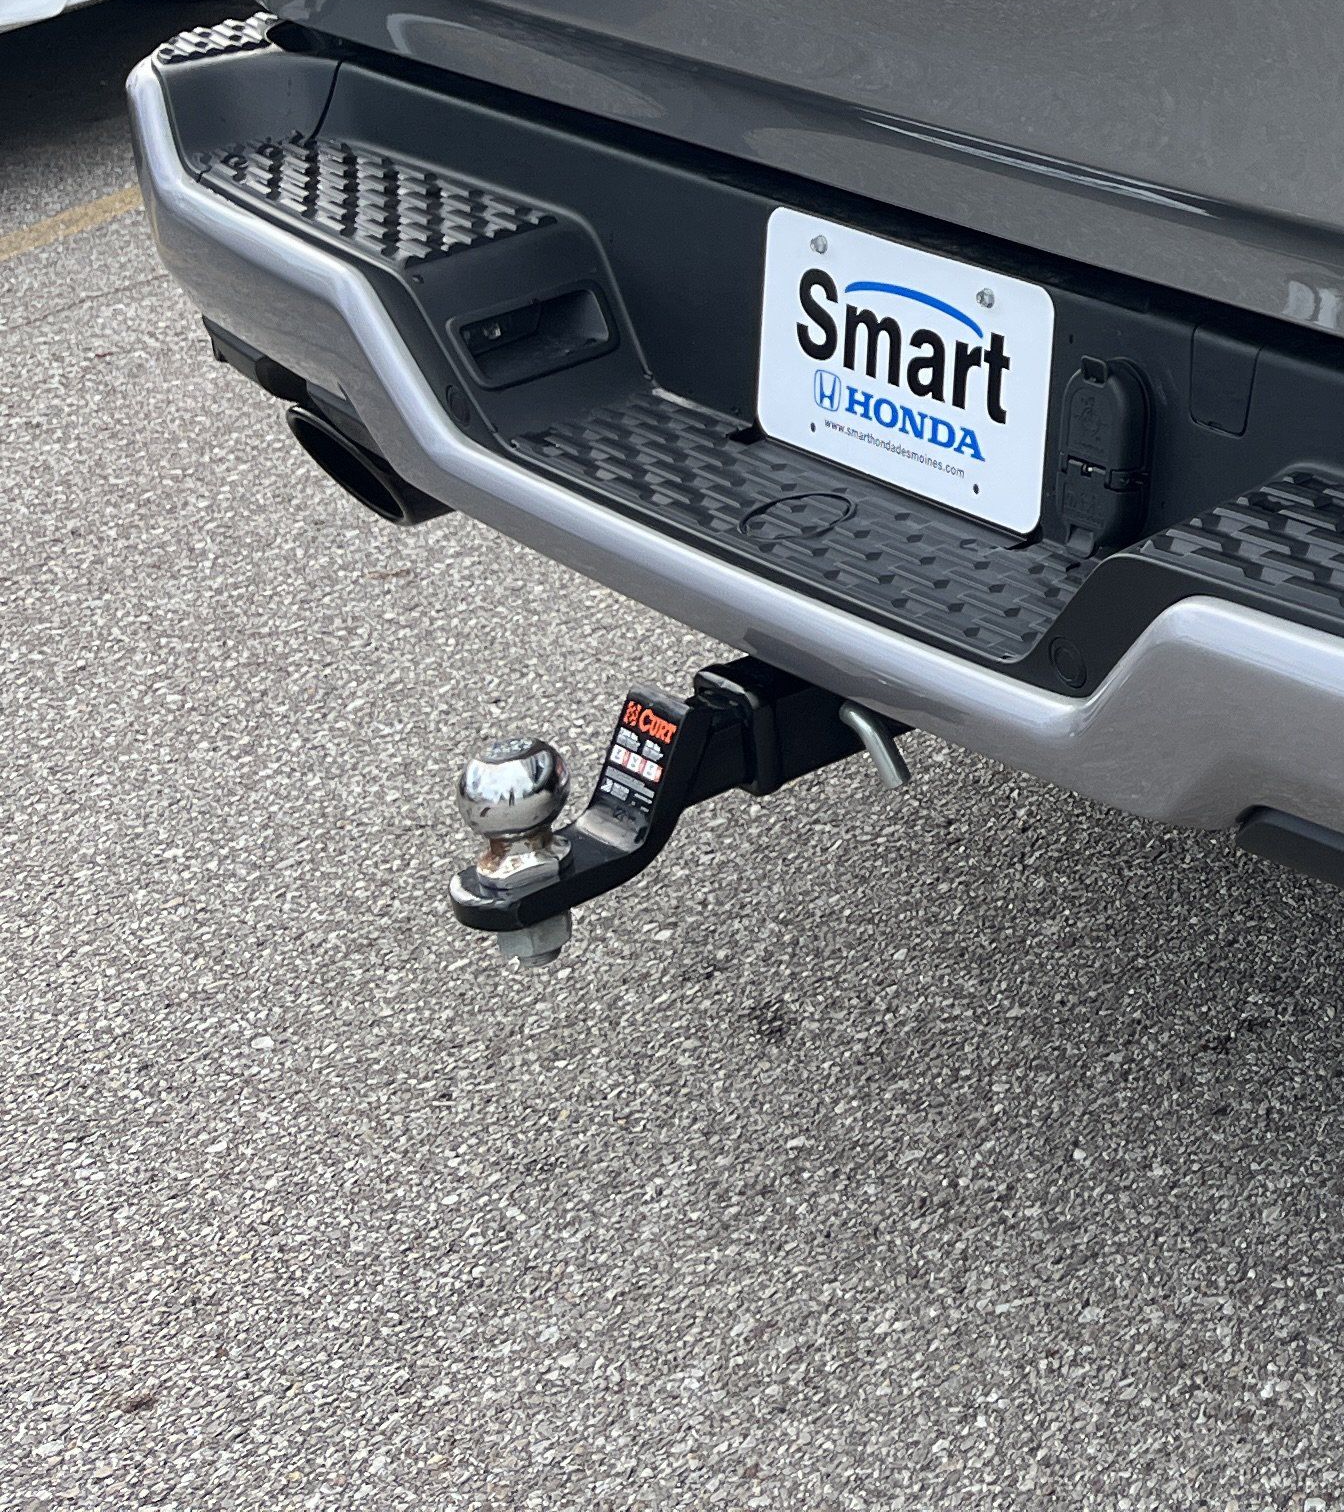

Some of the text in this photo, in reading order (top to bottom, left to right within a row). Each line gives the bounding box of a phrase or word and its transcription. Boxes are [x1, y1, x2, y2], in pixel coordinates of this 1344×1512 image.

[796, 267, 1010, 425] Smart
[823, 418, 966, 479] www.smarthondadesmoines.com
[844, 384, 986, 463] HONDA
